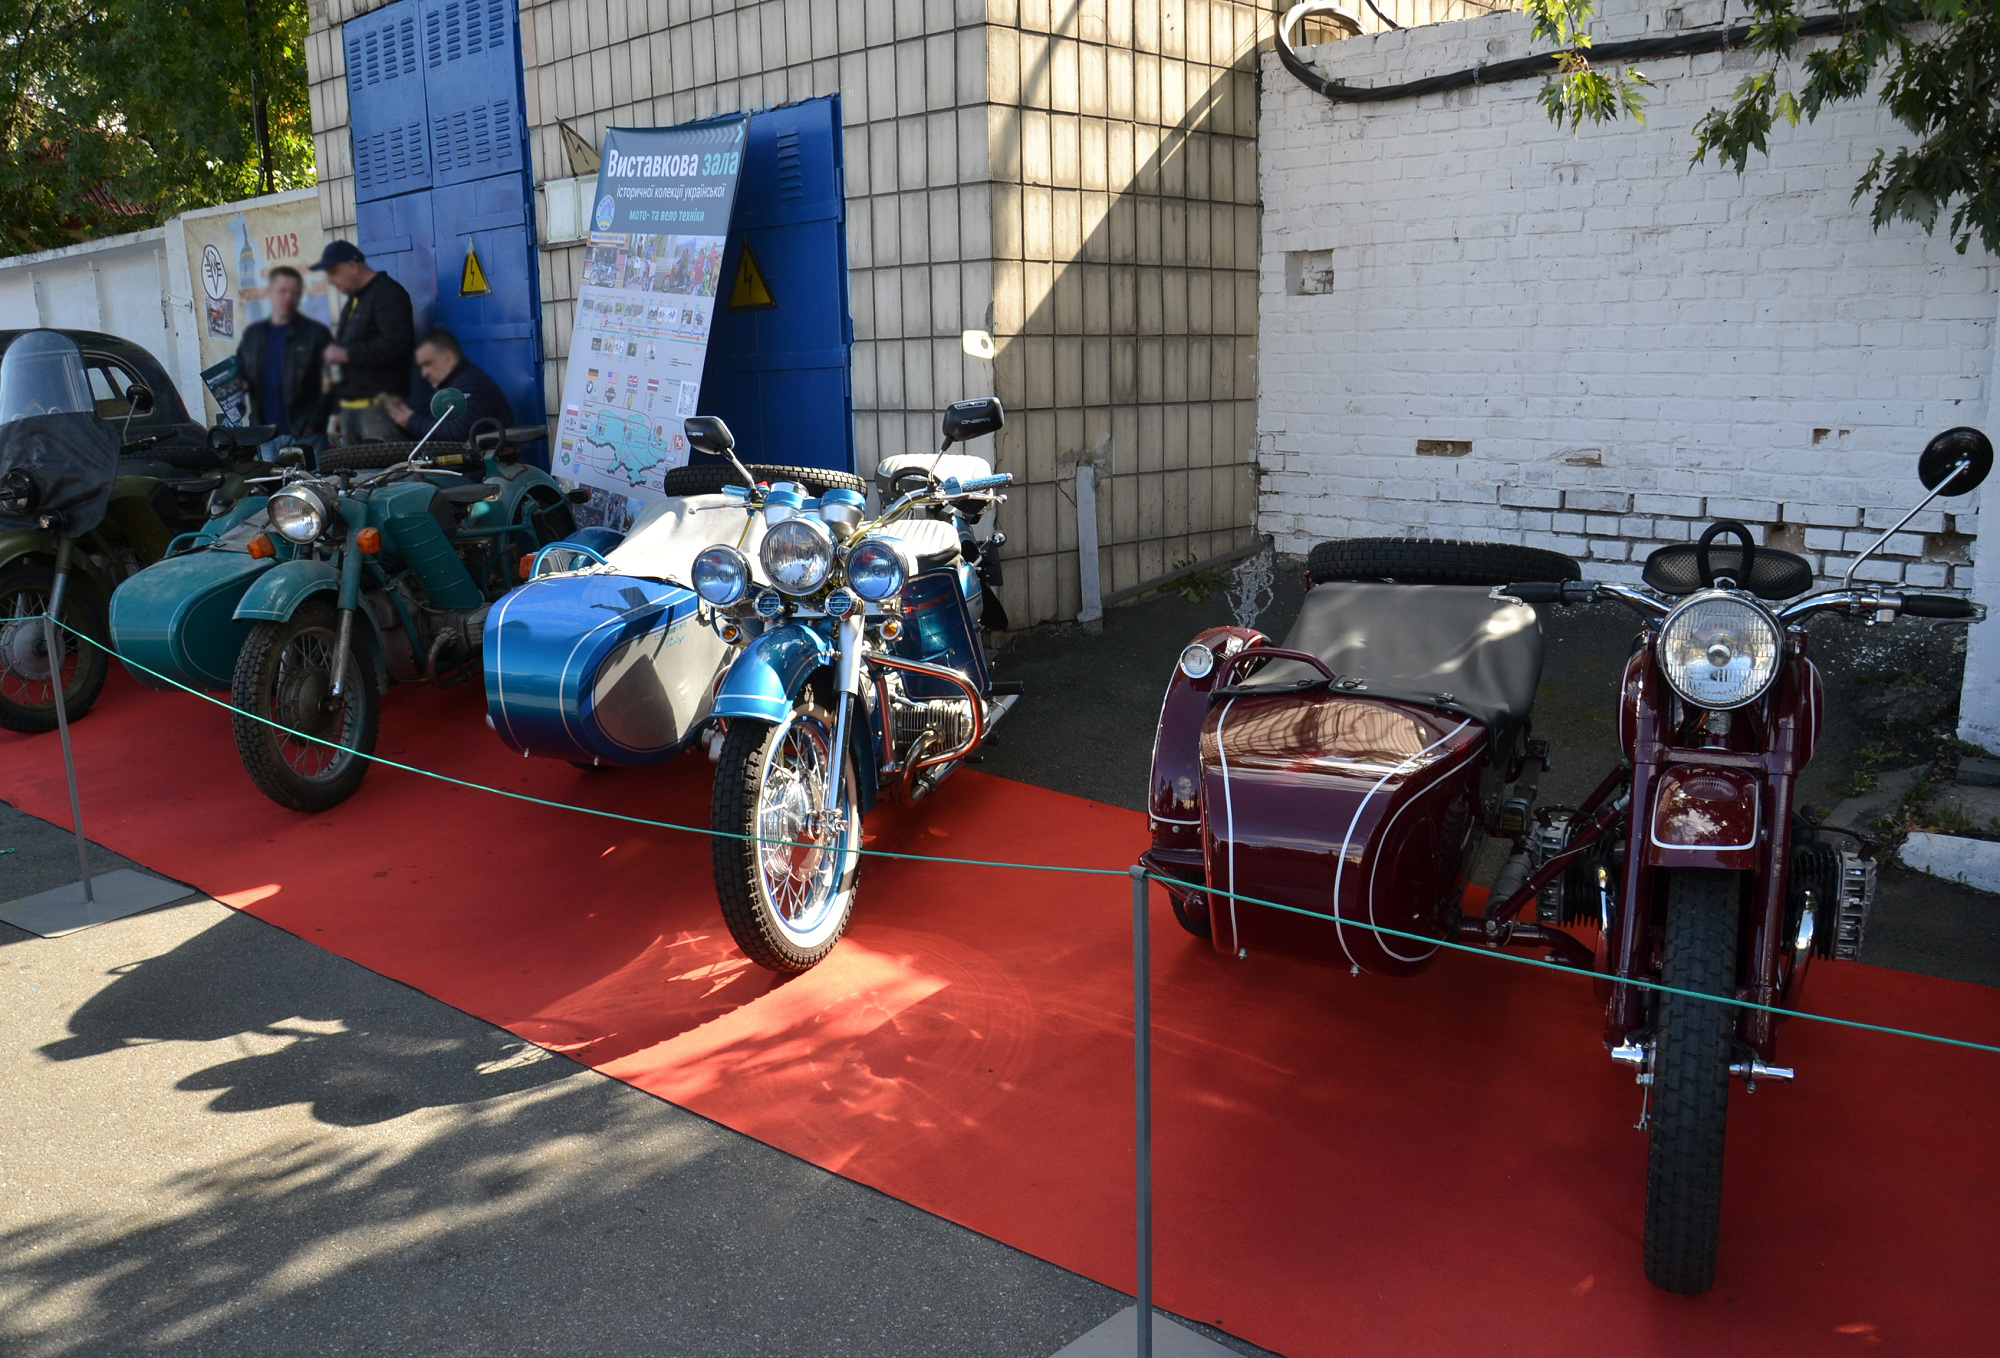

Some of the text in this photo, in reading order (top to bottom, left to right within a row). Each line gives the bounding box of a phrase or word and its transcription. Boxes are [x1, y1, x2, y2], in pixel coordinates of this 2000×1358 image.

[607, 149, 739, 178] Виставкова зала
[616, 183, 727, 201] історичної колекції української
[629, 208, 705, 221] мото- та вело техніки
[265, 232, 299, 260] КМЗ
